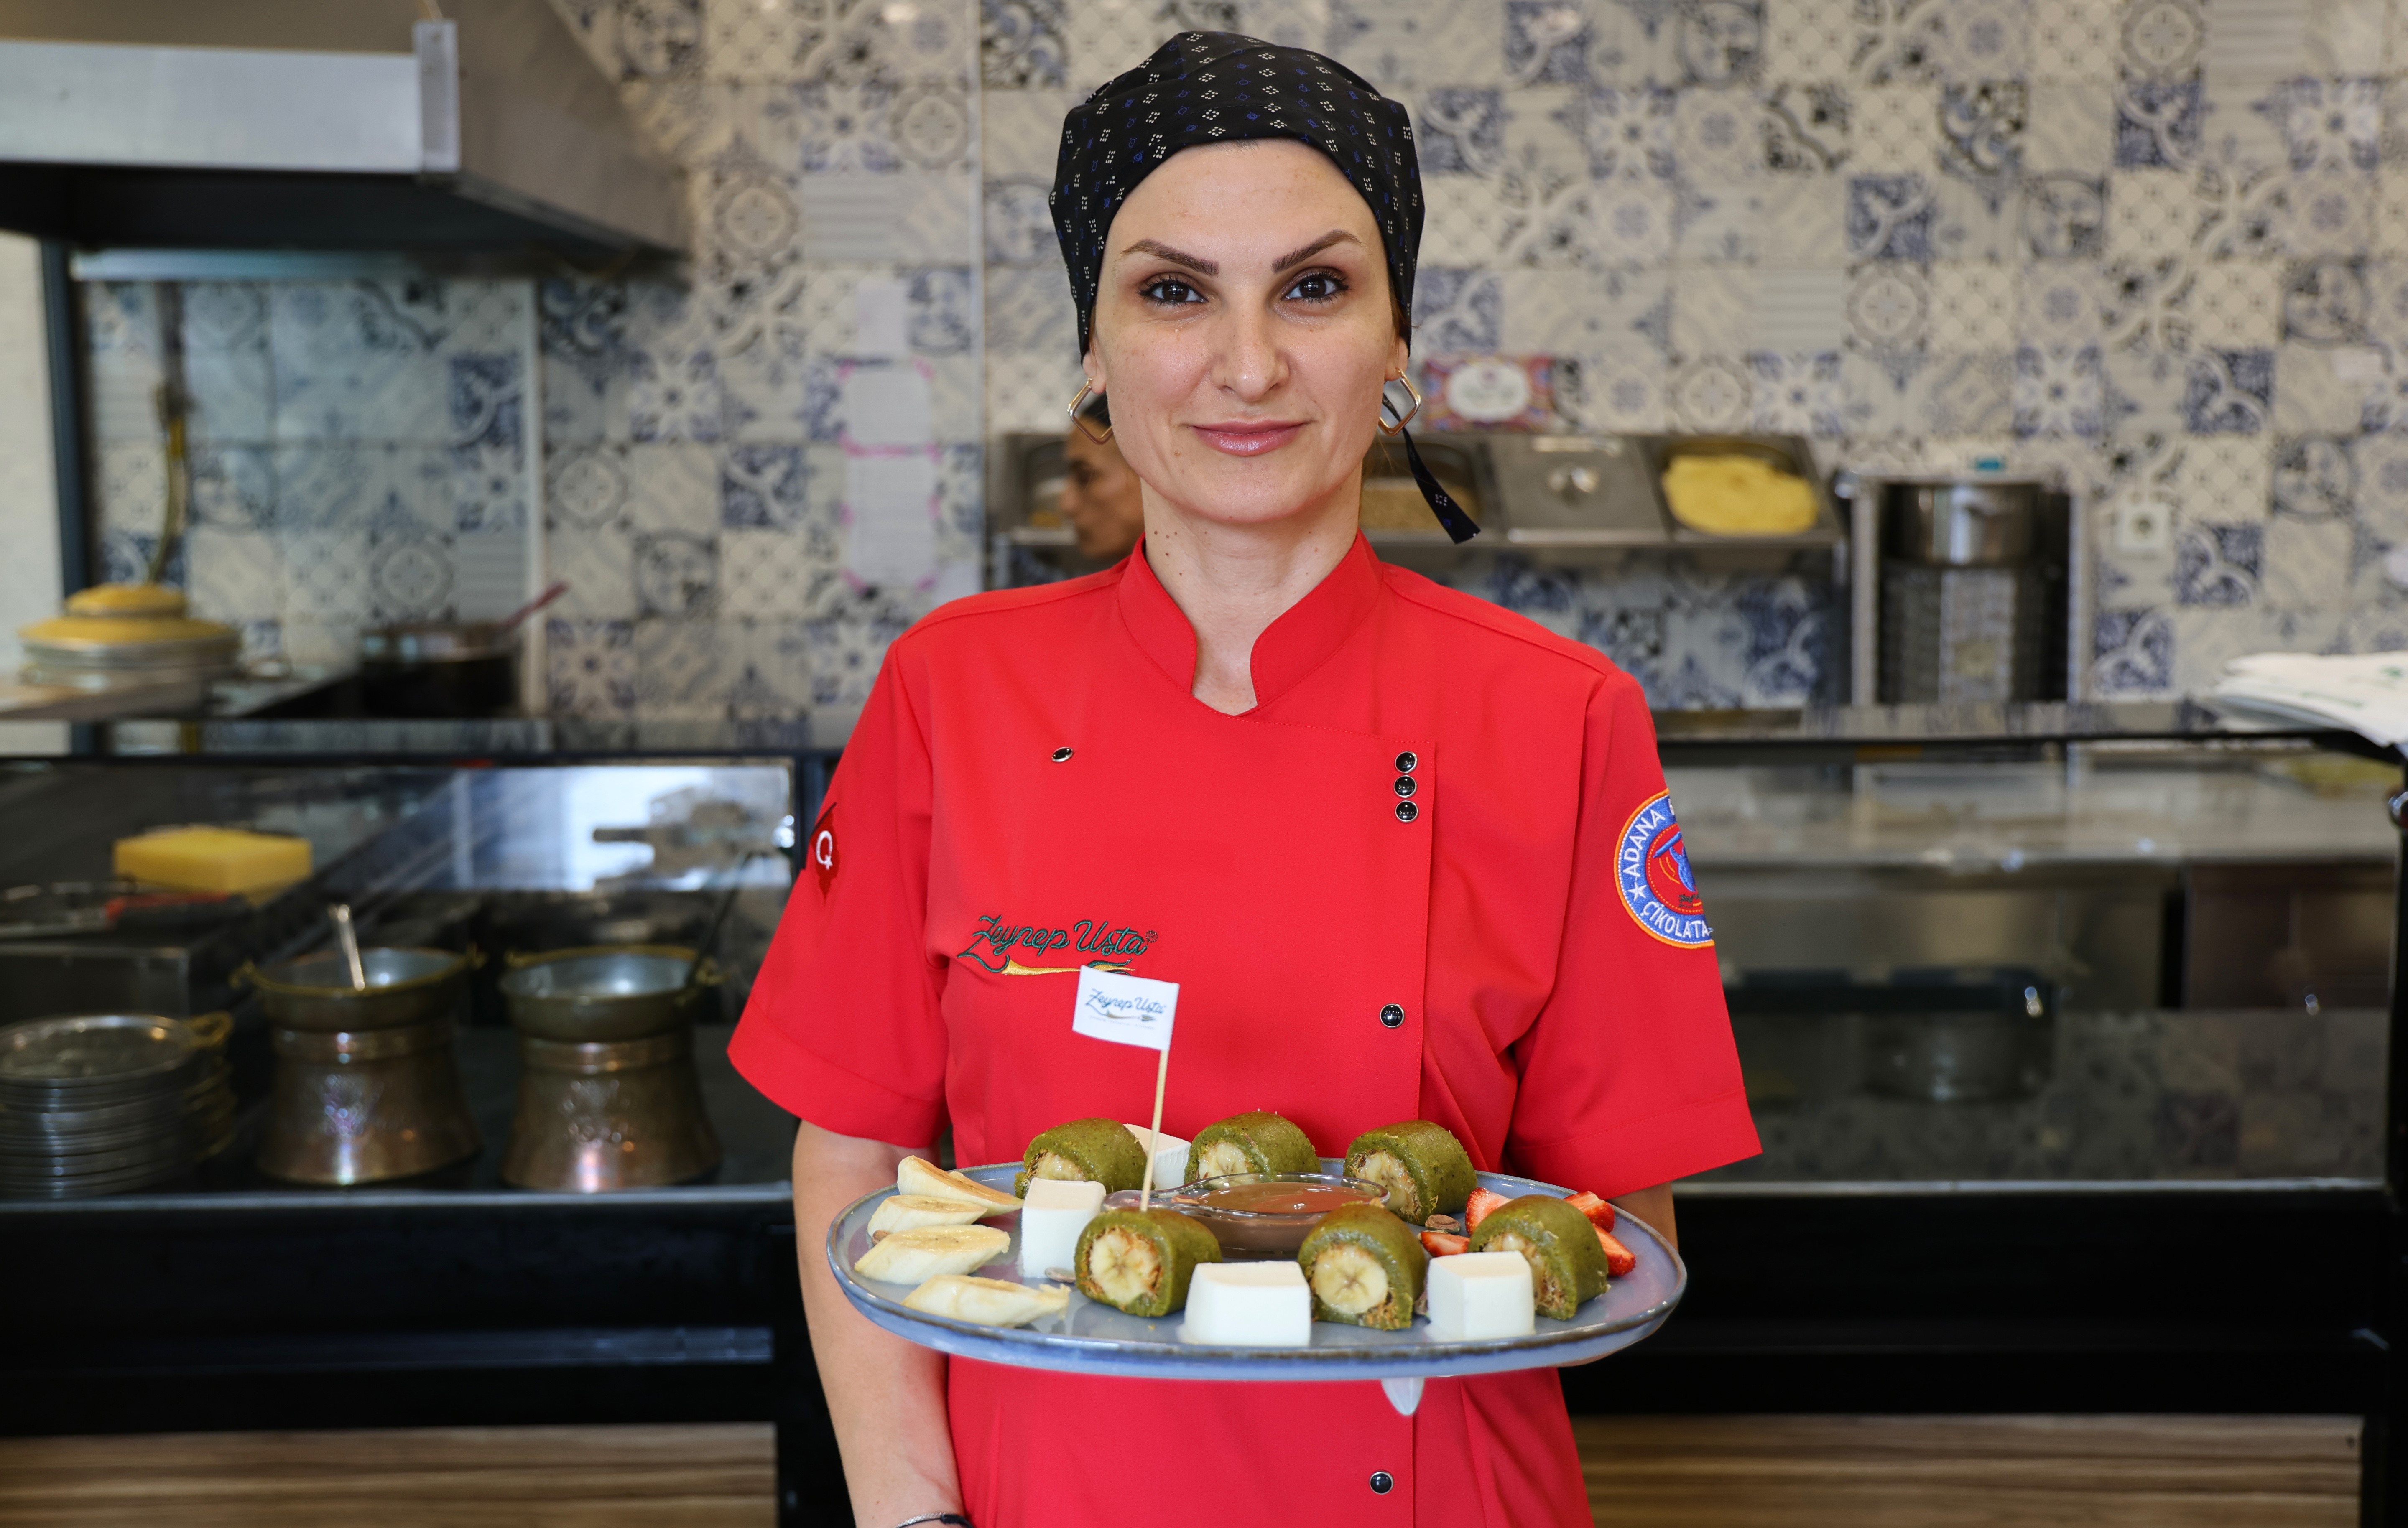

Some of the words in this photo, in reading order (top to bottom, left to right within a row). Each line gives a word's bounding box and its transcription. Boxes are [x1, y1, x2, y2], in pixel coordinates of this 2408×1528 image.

[1623, 809, 1665, 877] ADANA
[1640, 900, 1710, 938] ÇİKOLATA
[957, 914, 1070, 973] Zeynep
[1086, 988, 1133, 1016] Zeynep
